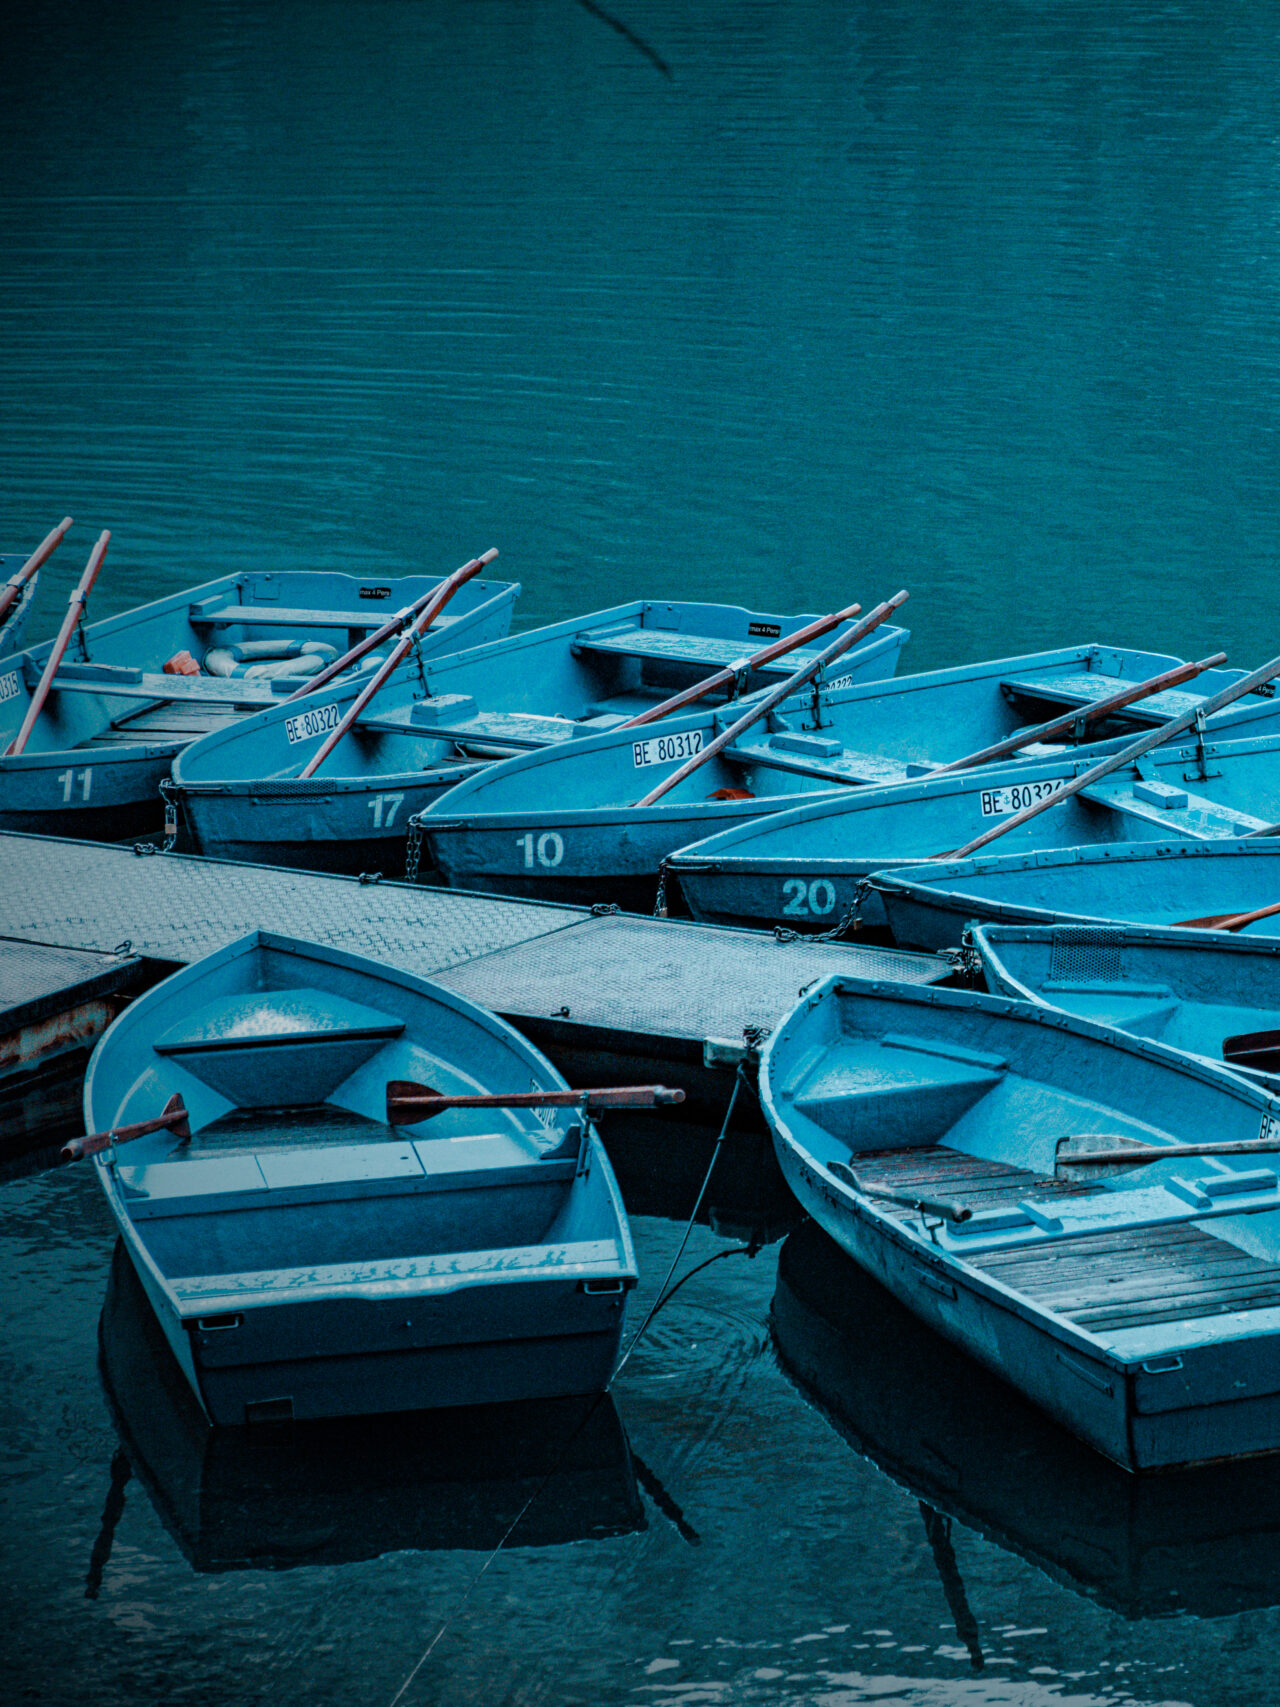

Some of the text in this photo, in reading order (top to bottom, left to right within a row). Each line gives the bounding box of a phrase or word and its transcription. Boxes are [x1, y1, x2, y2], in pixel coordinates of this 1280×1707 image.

[286, 705, 340, 742] BE 80322
[634, 732, 702, 766] BE 80312
[58, 768, 92, 802] 11
[981, 790, 1003, 815] BE
[368, 793, 405, 828] 17
[516, 832, 564, 868] 10
[782, 879, 836, 915] 20
